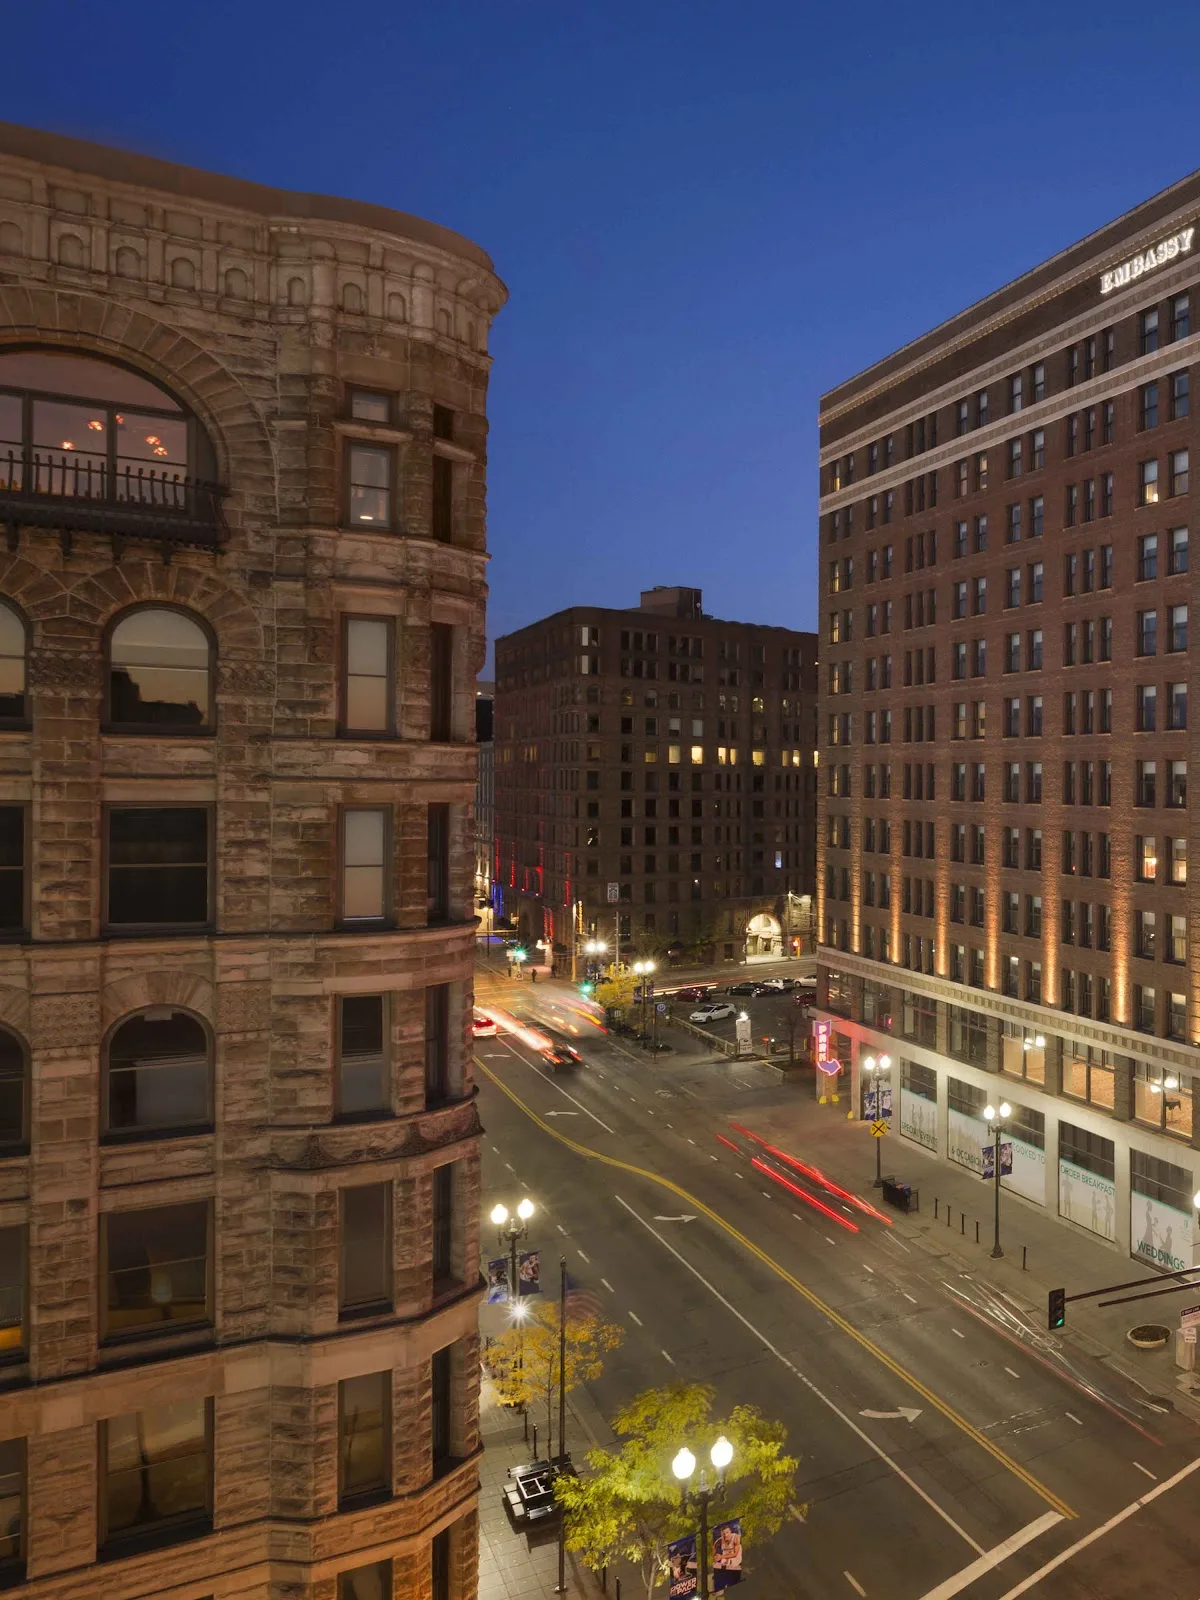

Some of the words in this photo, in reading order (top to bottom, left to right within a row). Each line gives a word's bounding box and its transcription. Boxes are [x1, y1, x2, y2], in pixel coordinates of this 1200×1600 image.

[1099, 228, 1195, 294] EMBASSY
[818, 1024, 828, 1062] PARK
[1060, 1164, 1081, 1181] ORDER
[1081, 1174, 1116, 1197] BREAKFAST
[1137, 1239, 1185, 1271] WEDDINGS
[670, 1577, 697, 1595] POWER
[676, 1584, 697, 1595] PACK
